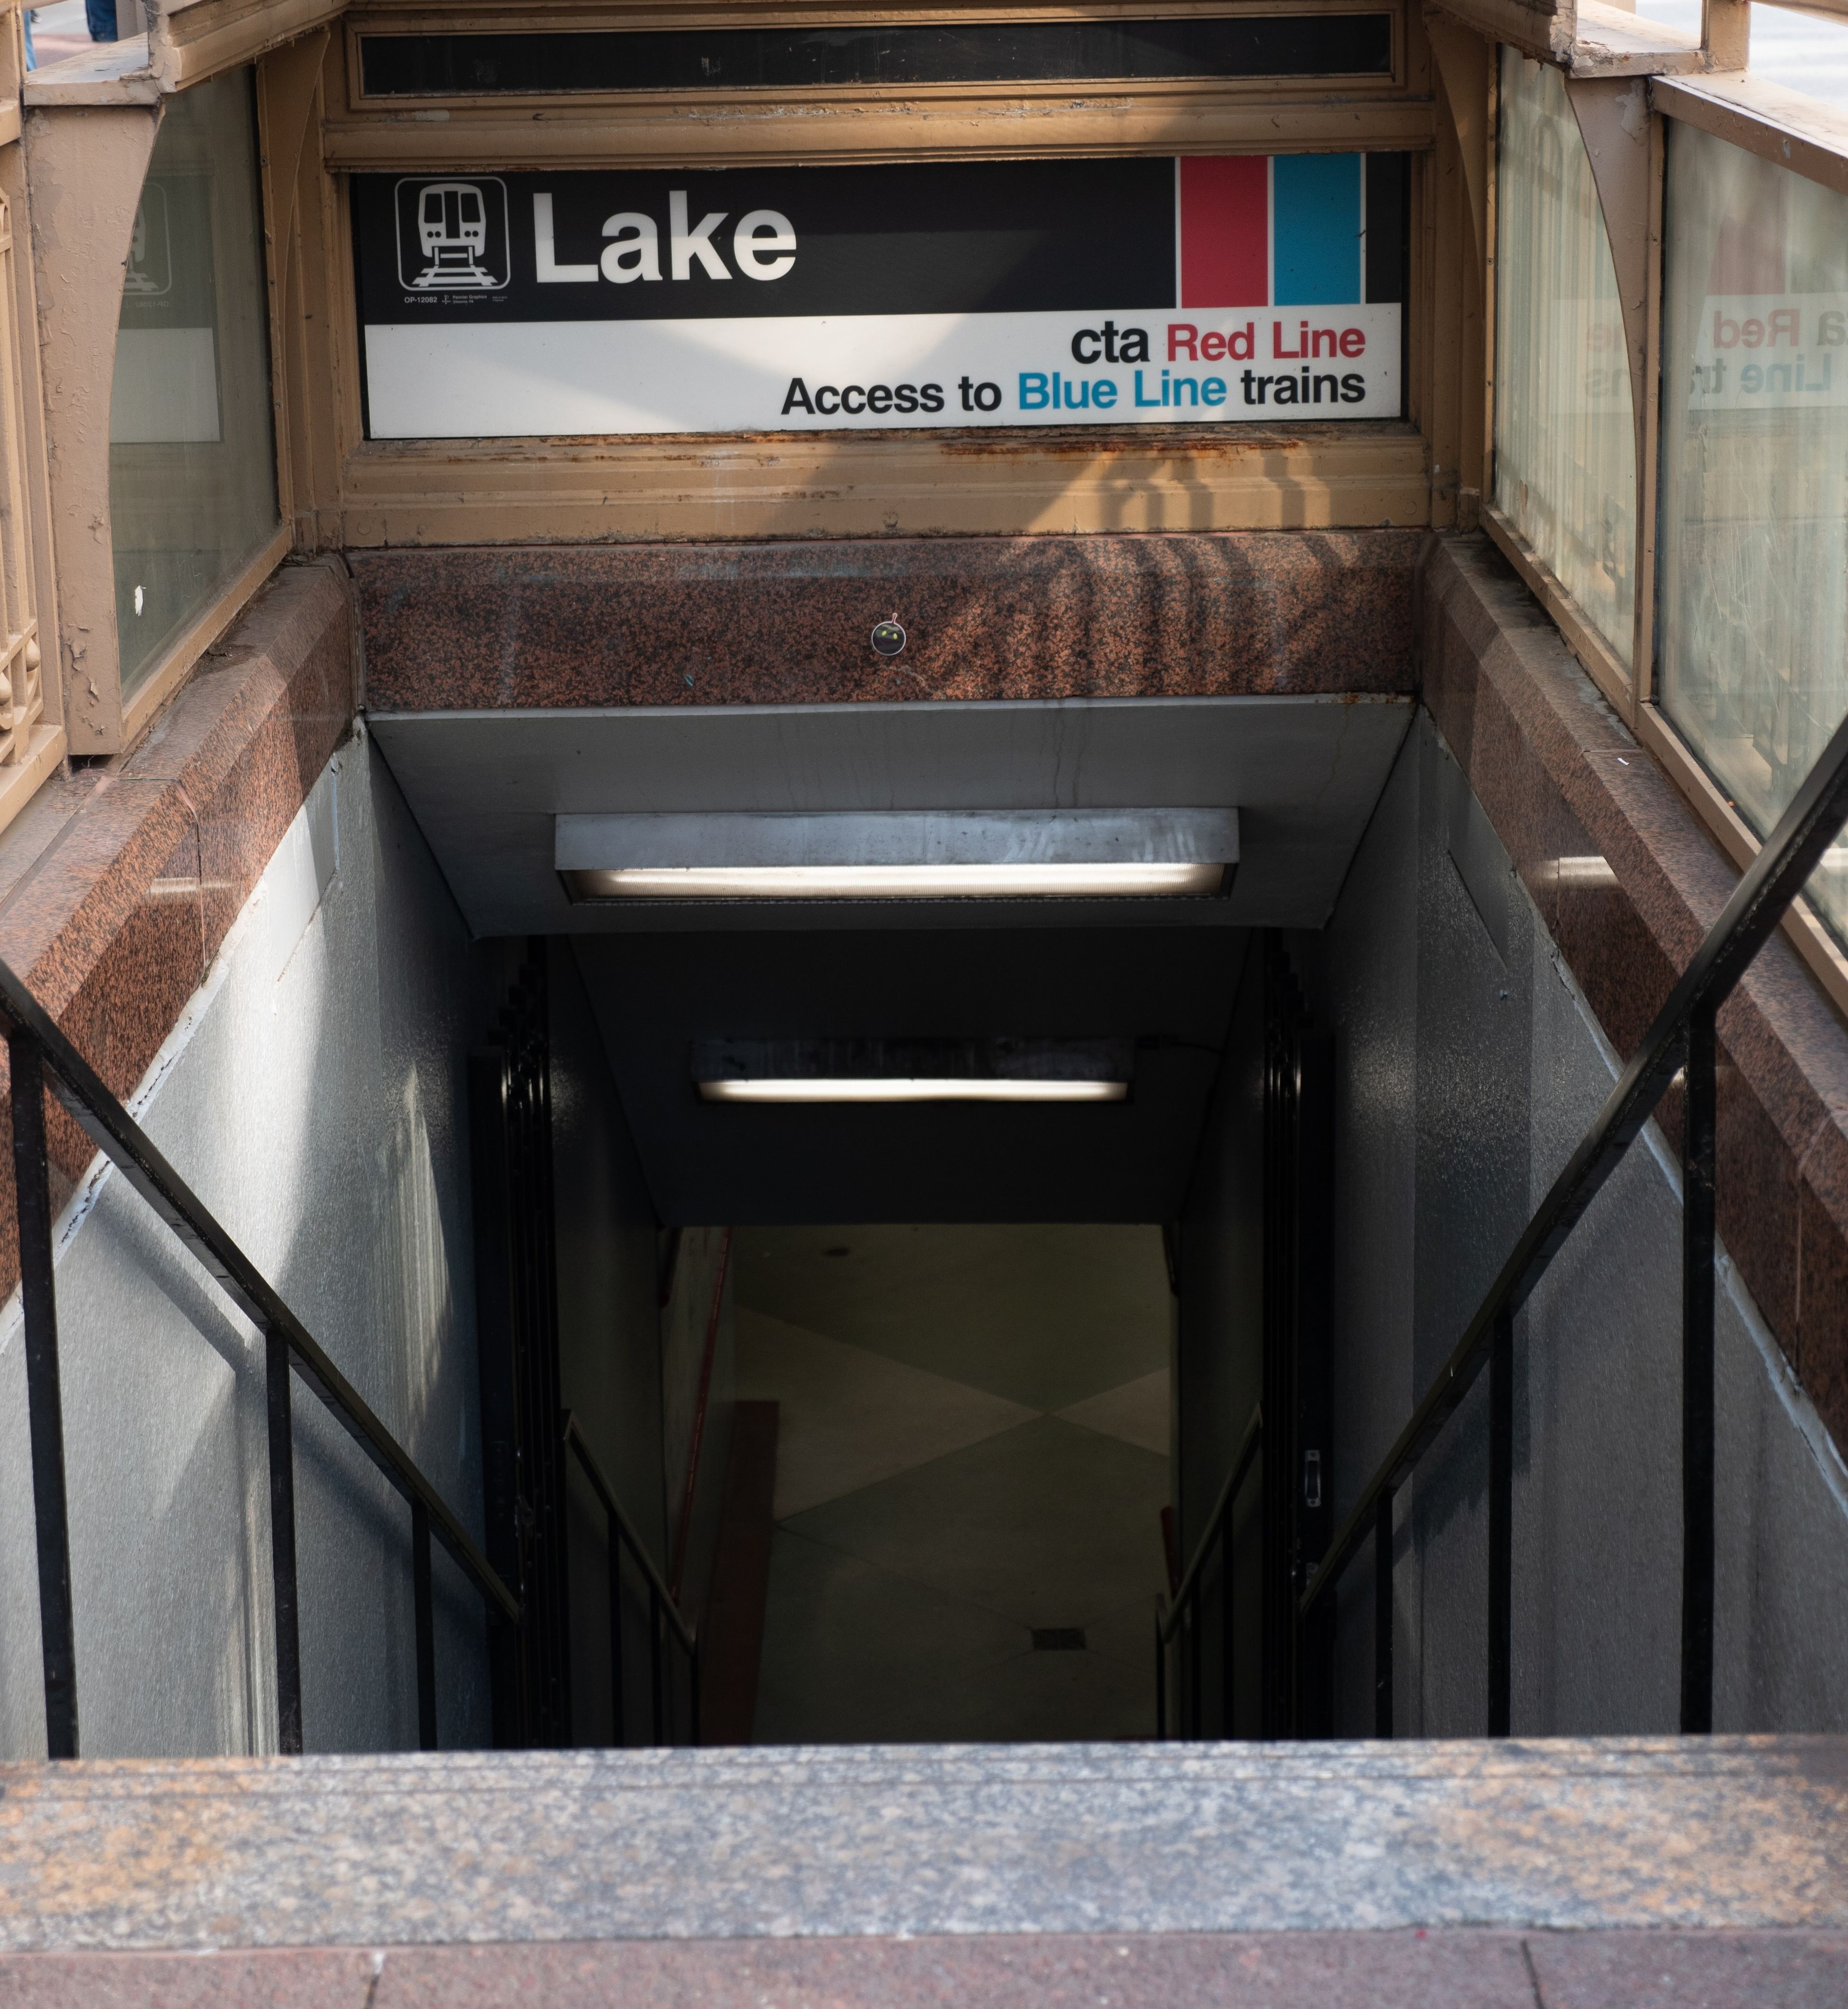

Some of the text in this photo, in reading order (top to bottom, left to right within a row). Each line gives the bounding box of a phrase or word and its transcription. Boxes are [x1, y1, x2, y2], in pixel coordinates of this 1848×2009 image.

[534, 191, 797, 284] Lake
[1071, 320, 1365, 364] cta Red Line
[781, 366, 1366, 415] Access to Blue Line trains
